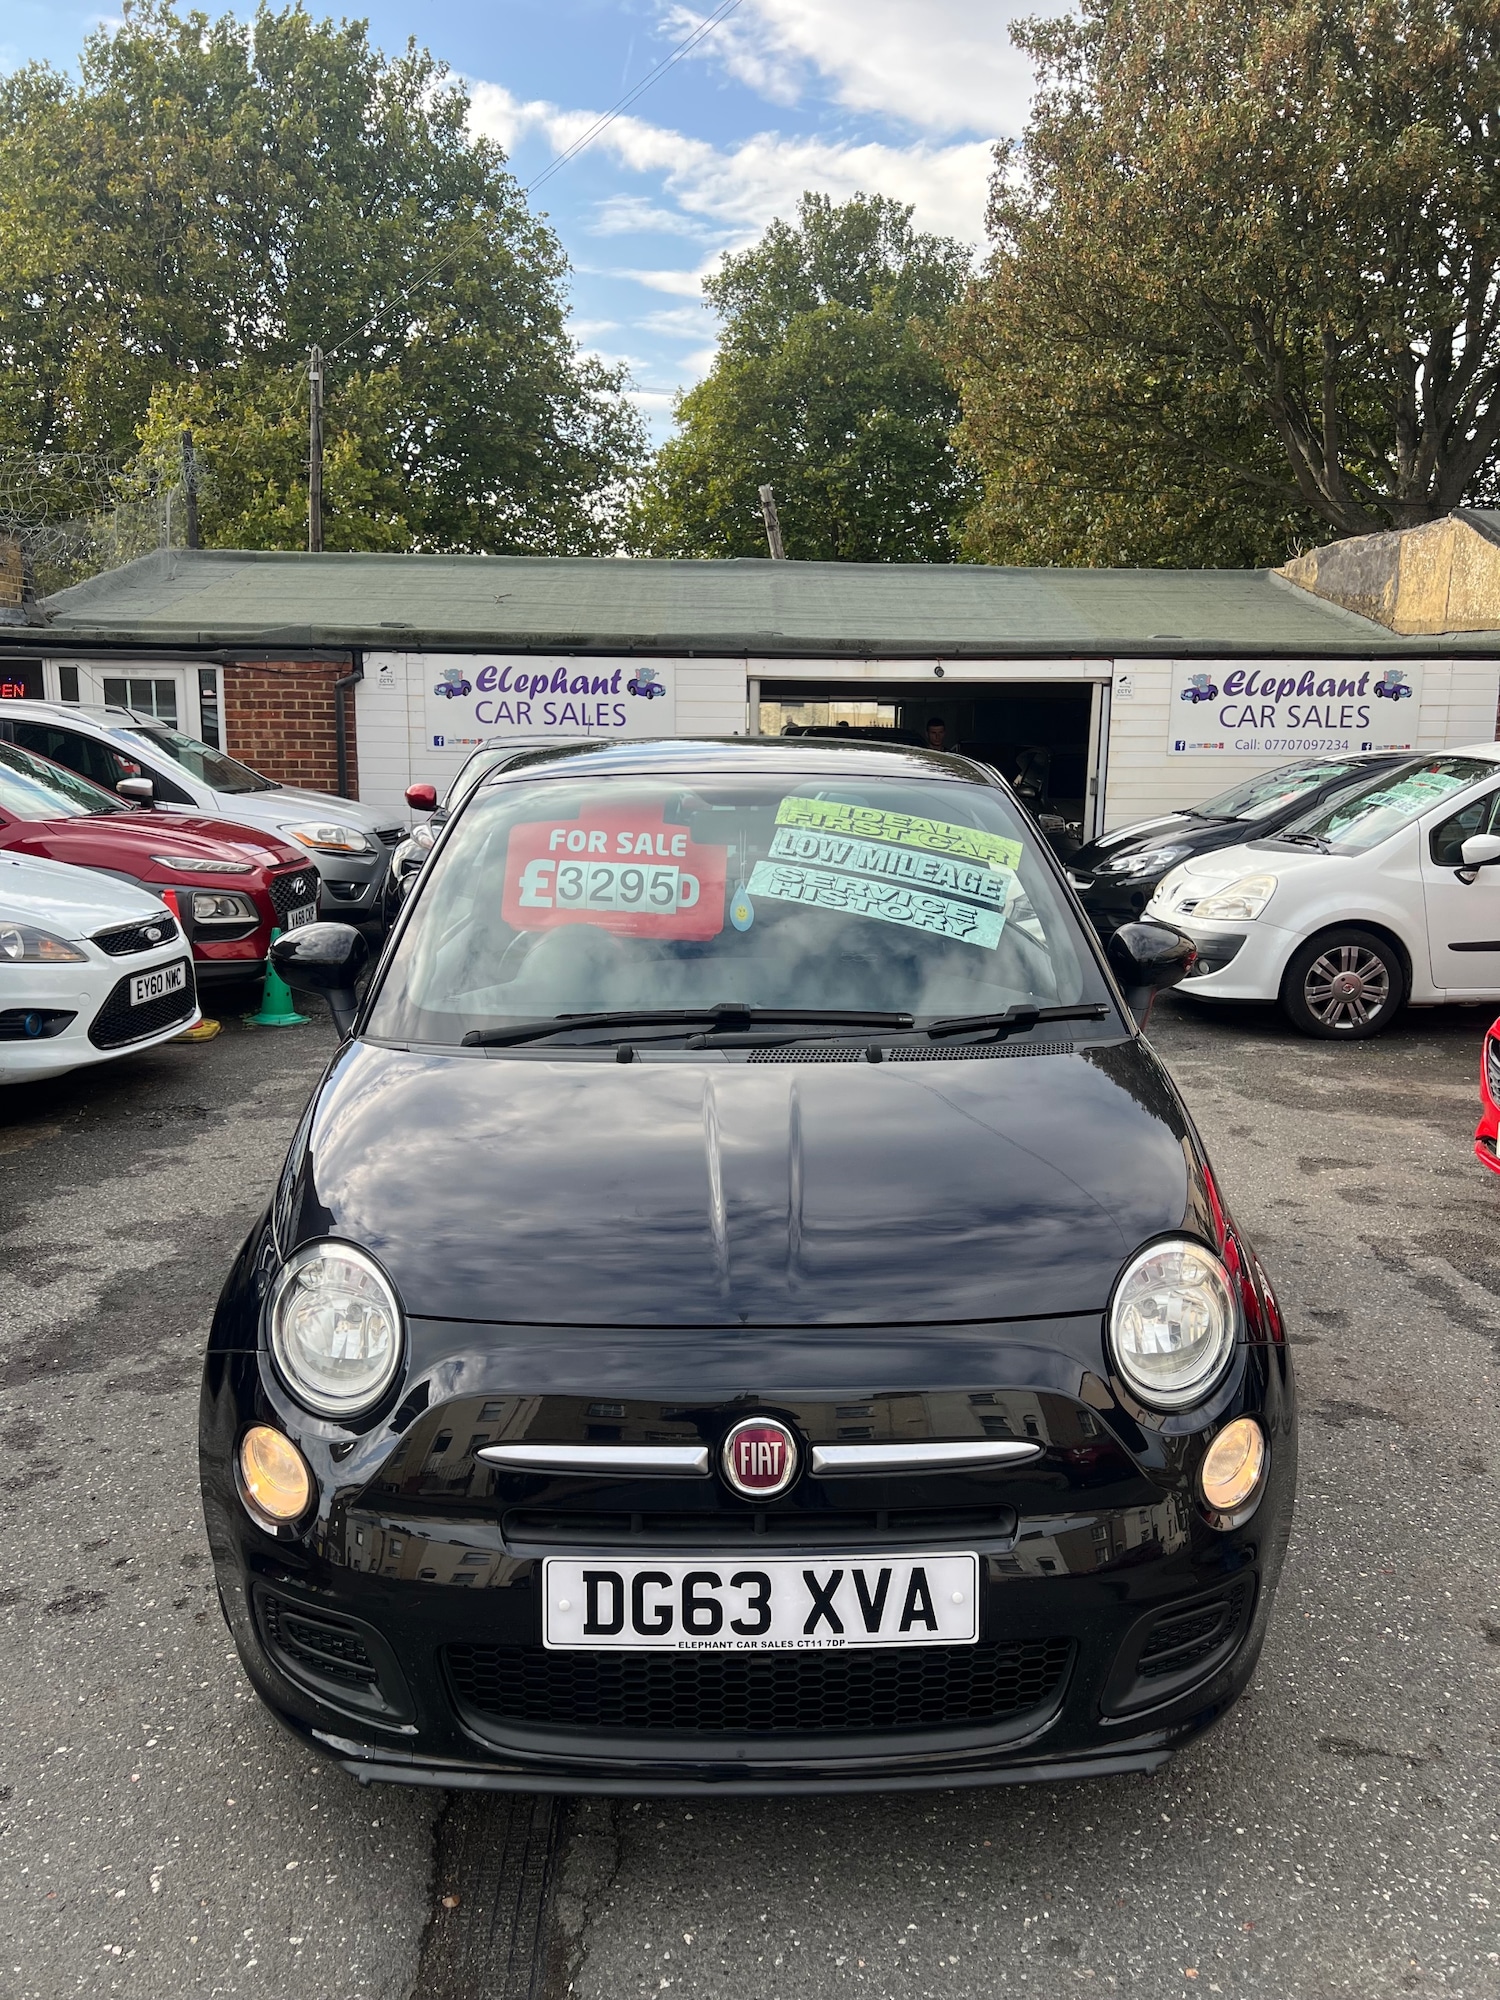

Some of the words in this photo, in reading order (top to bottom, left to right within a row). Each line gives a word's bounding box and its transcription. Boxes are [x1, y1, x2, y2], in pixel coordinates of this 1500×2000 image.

[0, 684, 25, 698] EN
[475, 665, 622, 700] Elephant
[1222, 669, 1371, 704] Elephant
[475, 701, 533, 725] CAR
[543, 702, 627, 727] SALES
[1219, 705, 1277, 729] CAR
[1286, 705, 1371, 729] SALES
[1234, 739, 1260, 751] Call:
[1264, 739, 1349, 751] 07707097234
[785, 809, 911, 842] FIRST
[917, 832, 1010, 866] CAR
[838, 804, 963, 840] IDEAL
[548, 828, 608, 854] FOR
[616, 832, 687, 857] SALE
[777, 833, 855, 865] LOW
[855, 845, 1010, 901] MILEAGE
[768, 878, 980, 938] HISTORY
[771, 865, 979, 925] SERVICE
[136, 974, 163, 1000] EY60
[740, 1441, 782, 1476] FIAT
[582, 1569, 772, 1637] DG63
[802, 1567, 939, 1635] XVA
[678, 1641, 733, 1649] ELEPHANT
[736, 1641, 758, 1649] CAR
[760, 1640, 794, 1648] SALES
[797, 1640, 822, 1648] CT11
[826, 1639, 846, 1647] 7DP
